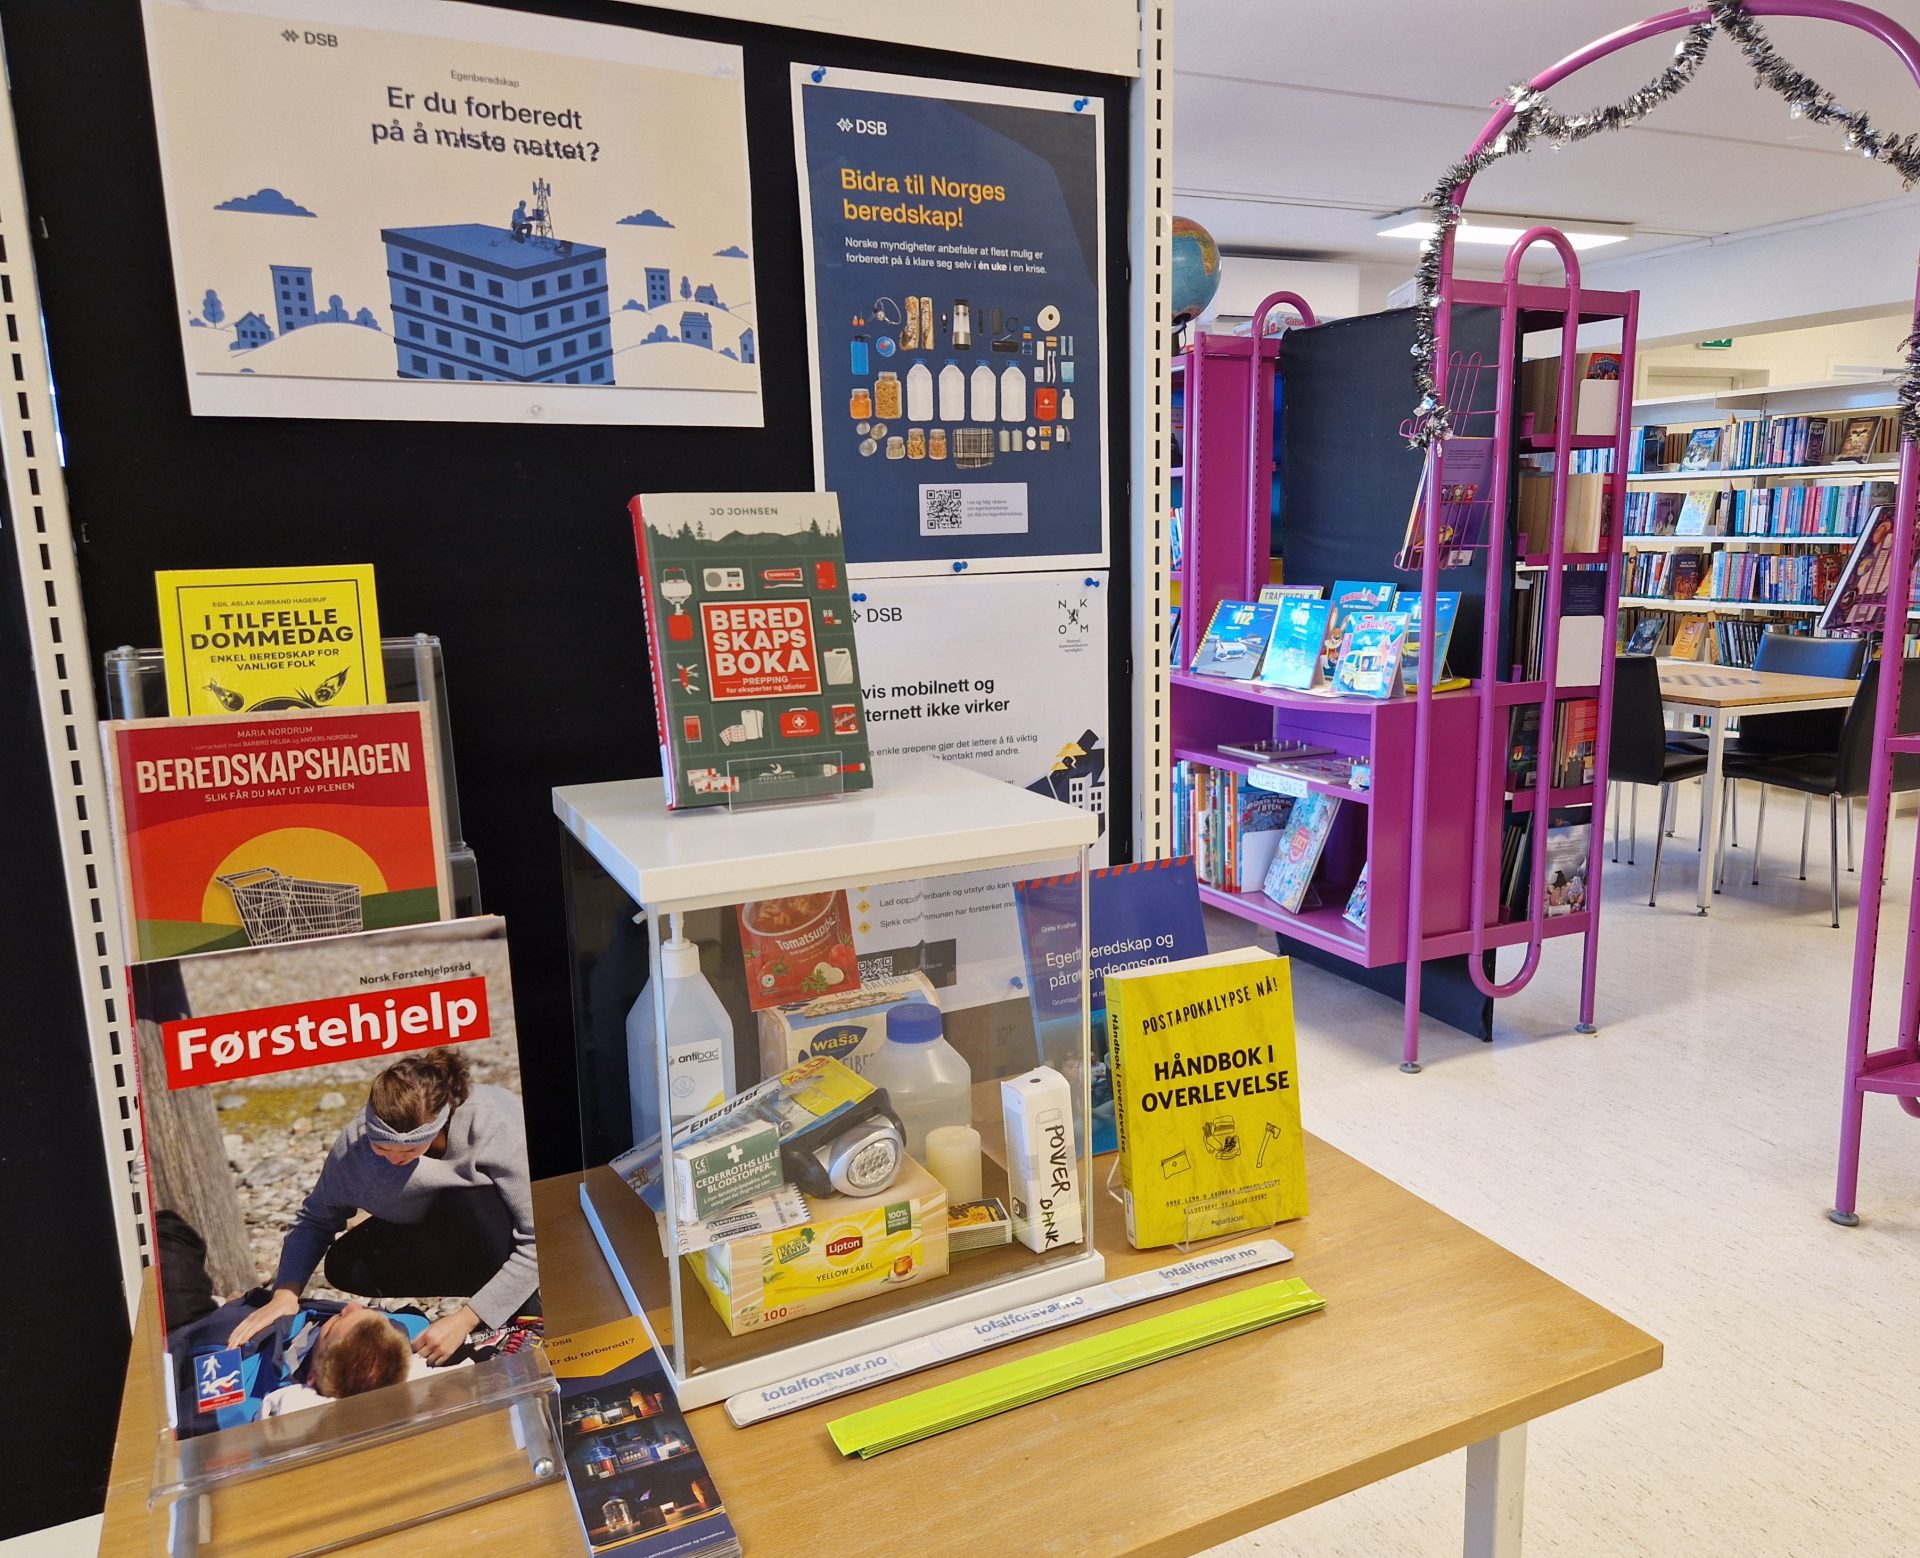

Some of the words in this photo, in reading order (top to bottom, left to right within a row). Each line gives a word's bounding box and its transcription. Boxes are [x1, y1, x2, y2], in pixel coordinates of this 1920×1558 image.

[304, 31, 338, 47] DSB
[450, 70, 520, 88] Egenberedskap
[387, 86, 415, 109] Er
[424, 92, 457, 115] du
[465, 96, 583, 130] forberedt
[856, 119, 887, 136] DSB
[372, 120, 404, 144] på
[414, 121, 428, 144] å
[435, 127, 506, 152] miste
[514, 137, 600, 163] nettet?
[840, 168, 899, 193] Bidra
[904, 174, 924, 195] til
[931, 176, 1006, 205] Norges
[843, 199, 964, 231] beredskap!
[845, 237, 878, 249] Norske
[881, 241, 936, 254] myndigheter
[938, 243, 978, 255] anbefaler
[980, 248, 988, 256] at
[991, 248, 1008, 258] flest
[1011, 249, 1032, 260] mulig
[1034, 251, 1043, 260] er
[846, 253, 888, 265] forberedt
[891, 255, 902, 267] på
[905, 256, 911, 265] å
[913, 257, 934, 268] klare
[936, 259, 952, 270] seg
[955, 260, 972, 270] selv
[978, 261, 990, 271] én
[991, 262, 1007, 272] uke
[1026, 264, 1047, 274] krise.
[710, 508, 724, 516] JO
[727, 507, 778, 516] JOHNSEN
[205, 615, 211, 630] I
[219, 609, 337, 629] TILFELLE
[710, 607, 804, 631] BERED
[867, 607, 903, 623] DSB
[191, 626, 354, 650] DOMMEDAG
[713, 628, 807, 652] SKAPS
[211, 654, 246, 663] ENKEL
[250, 651, 314, 661] BEREDSKAP
[237, 662, 284, 671] VANLIGE
[287, 660, 316, 668] FOLK
[715, 650, 809, 676] BOKA
[738, 685, 772, 694] eksperter
[742, 676, 788, 685] PREPPING
[862, 685, 886, 699] vis
[892, 679, 969, 697] mobilnett
[974, 679, 994, 694] og
[865, 705, 922, 722] ternett
[927, 703, 960, 717] ikke
[965, 699, 1010, 713] virker
[237, 729, 266, 738] MARIA
[267, 726, 313, 736] NORDRUM
[877, 747, 900, 756] enkle
[902, 744, 936, 754] grepene
[939, 742, 954, 752] gjør
[956, 740, 969, 749] det
[972, 738, 997, 747] lettere
[999, 736, 1004, 744] å
[1006, 735, 1014, 743] få
[1016, 734, 1038, 743] viktig
[942, 751, 974, 761] kontakt
[976, 750, 993, 758] med
[995, 747, 1020, 757] andre.
[136, 742, 411, 793] BEREDSKAPSHAGEN
[205, 794, 228, 803] SLIK
[229, 789, 249, 800] FÅR
[251, 790, 265, 798] DU
[267, 788, 287, 797] MAT
[289, 787, 301, 795] UT
[303, 785, 317, 794] AV
[318, 783, 355, 792] PLENEN
[952, 889, 962, 897] og
[964, 885, 985, 894] utstyr
[880, 919, 901, 928] Sjekk
[969, 903, 1002, 913] forsterket
[775, 916, 836, 951] Tomatsuppe
[1156, 934, 1174, 948] og
[359, 973, 390, 986] Norsk
[392, 962, 471, 984] Førstehjelpsråd
[1143, 986, 1251, 1035] POSTAPOKALYPSE
[1256, 976, 1278, 997] NÅ!
[178, 991, 478, 1071] Førstehjelp
[812, 1033, 860, 1051] wasa
[1112, 1014, 1121, 1070] Håndbok
[678, 1050, 719, 1063] antibac
[1154, 1047, 1262, 1081] HÅNDBOK
[1268, 1045, 1274, 1062] I
[1142, 1070, 1290, 1112] OVERLEVELSE
[689, 1088, 760, 1133] Energizer
[1116, 1080, 1126, 1153] overlevelse
[696, 1159, 756, 1189] CEDERROTHS
[757, 1149, 780, 1164] LILLE
[1045, 1124, 1071, 1198] POWER
[707, 1162, 772, 1194] BLODSTOPPER.
[887, 1209, 907, 1219] 100%
[1040, 1198, 1060, 1249] BANK
[781, 1242, 808, 1258] KENYA
[829, 1240, 860, 1255] Lipton
[816, 1269, 849, 1282] YELLOW
[851, 1262, 874, 1274] LABEL
[1158, 1247, 1258, 1281] totalforsvar.no
[764, 1307, 787, 1322] 100
[973, 1296, 1085, 1336] totalforsvar.no
[552, 1338, 572, 1347] DSB
[580, 1338, 635, 1358] forberedt?
[761, 1355, 888, 1402] totalforsvar.no
